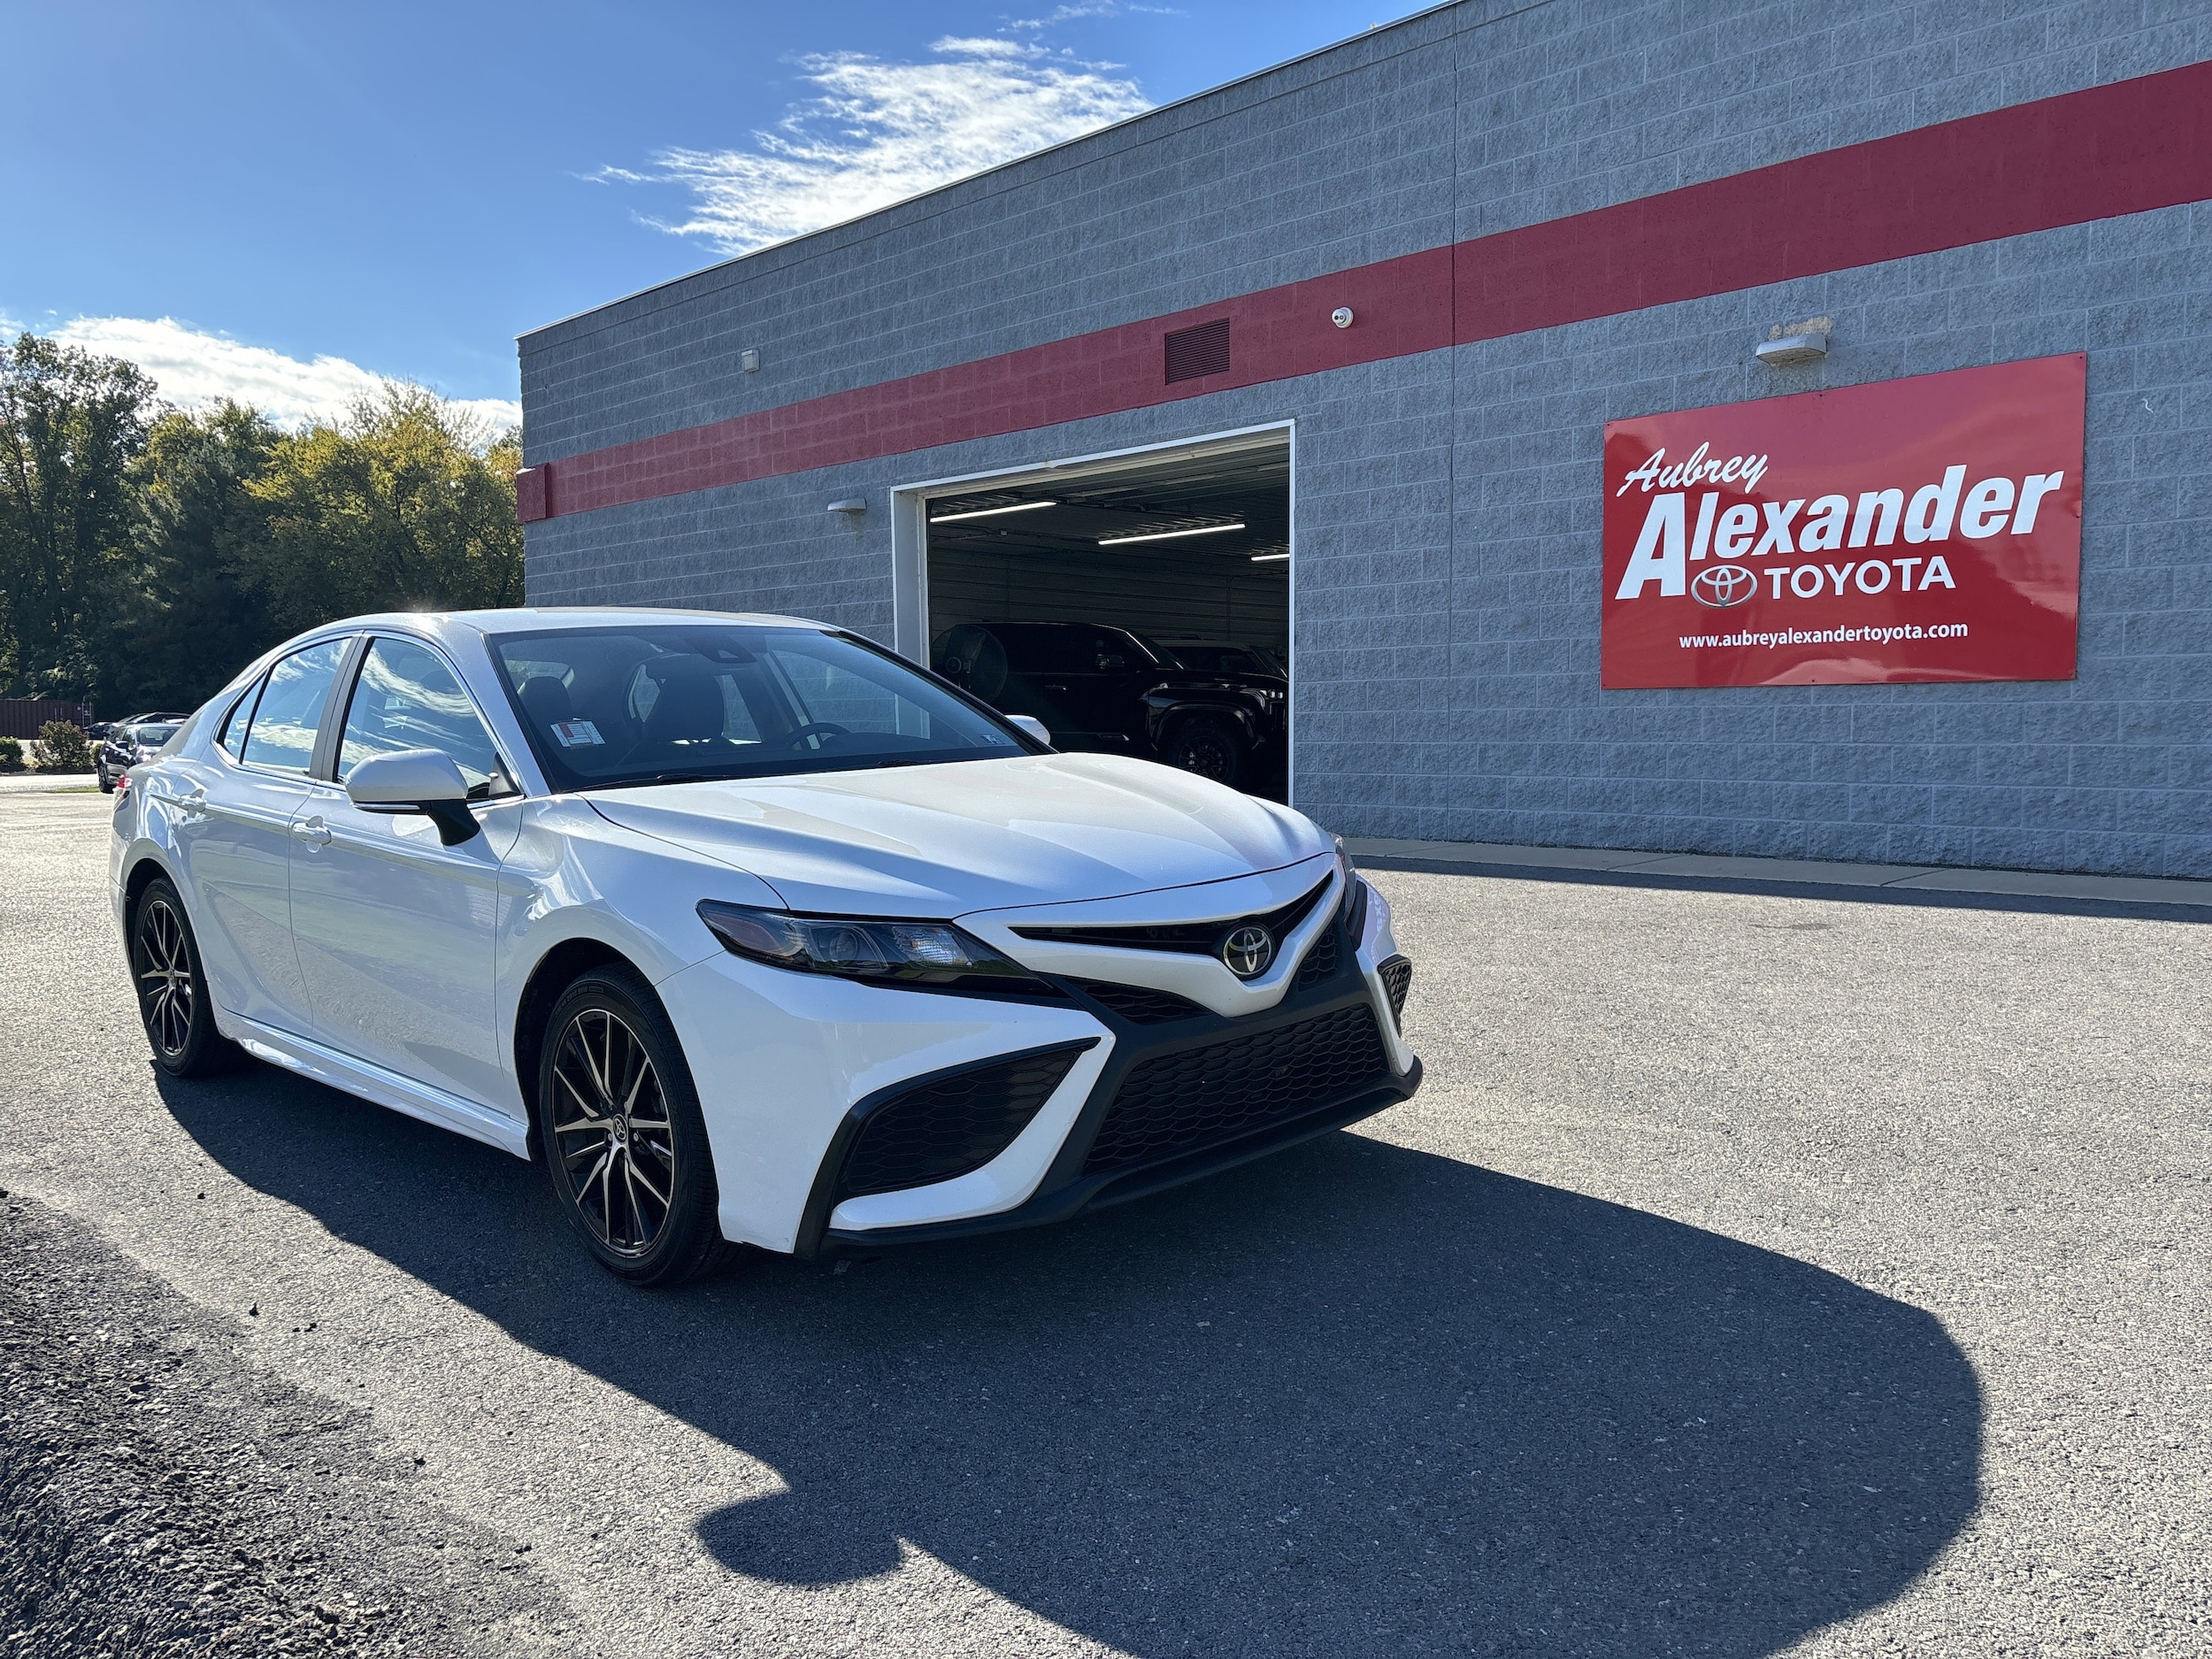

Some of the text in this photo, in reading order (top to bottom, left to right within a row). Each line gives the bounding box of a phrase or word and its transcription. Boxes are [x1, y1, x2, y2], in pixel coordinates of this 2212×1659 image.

[1616, 442, 1769, 496] Aubrey
[1615, 464, 2064, 600] Alexander
[1764, 556, 1956, 600] TOYOTA
[1678, 623, 1968, 649] www.aubreyalexandertoyota.com
